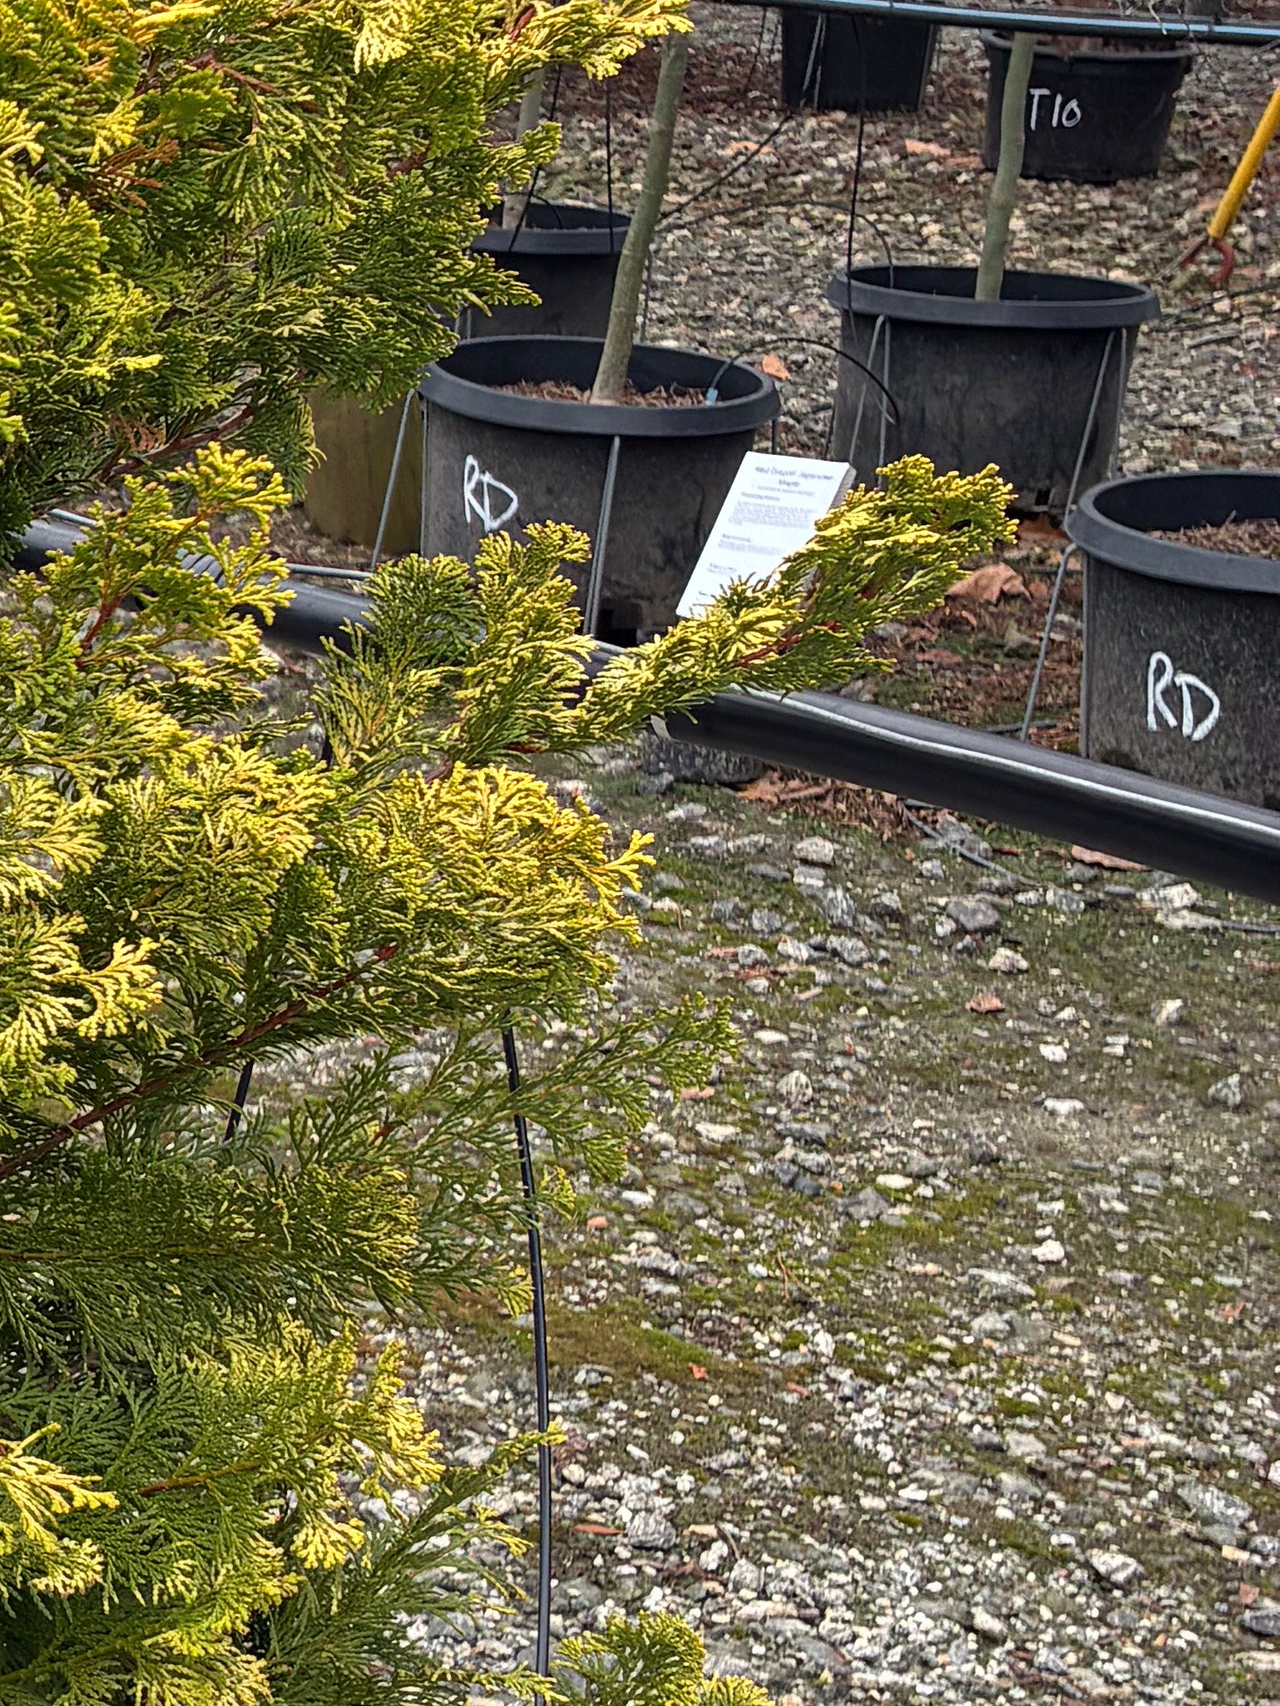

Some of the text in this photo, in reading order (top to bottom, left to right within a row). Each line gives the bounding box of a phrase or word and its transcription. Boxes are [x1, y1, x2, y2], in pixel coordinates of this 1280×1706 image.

[1029, 88, 1082, 131] T10
[464, 454, 518, 533] RD
[1147, 650, 1220, 741] RD
